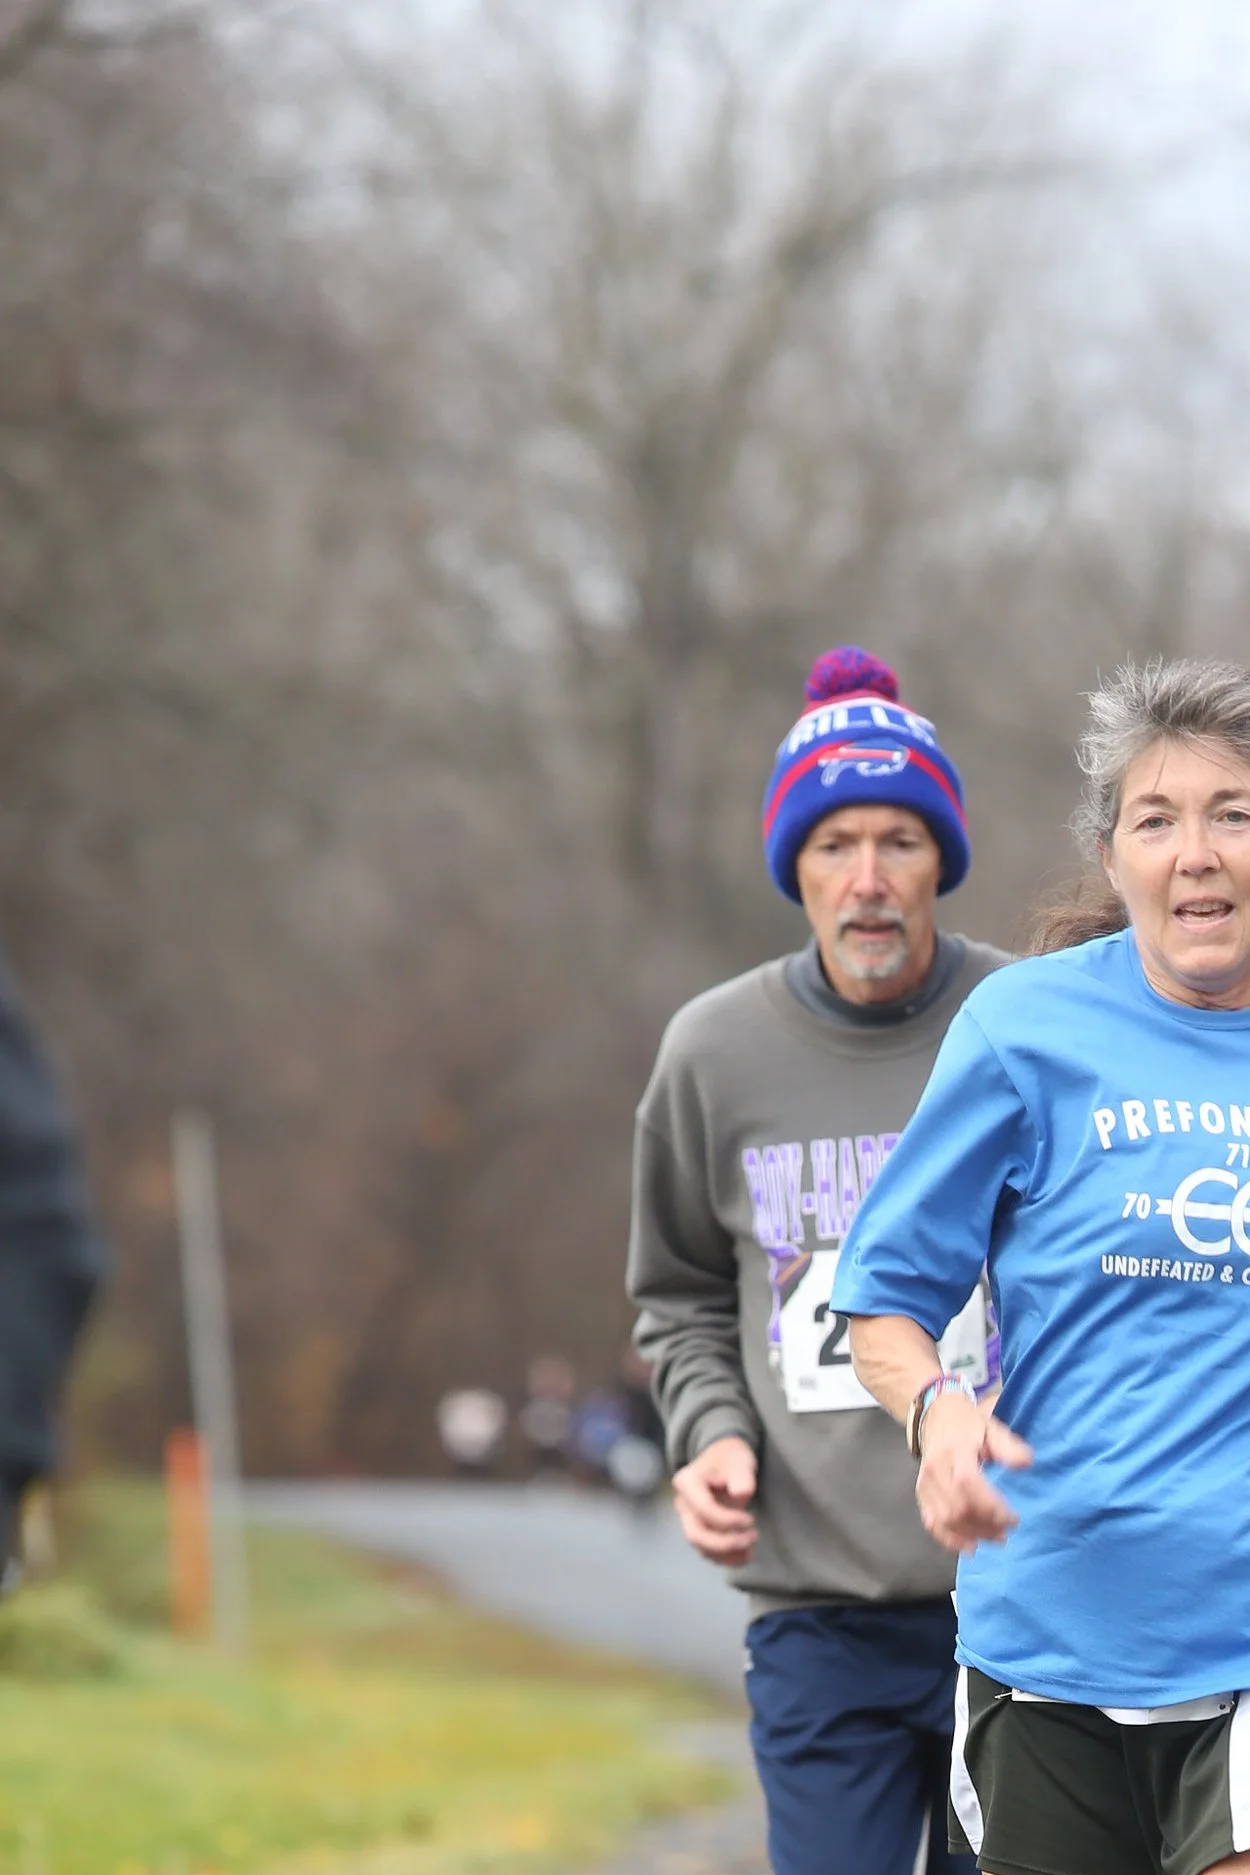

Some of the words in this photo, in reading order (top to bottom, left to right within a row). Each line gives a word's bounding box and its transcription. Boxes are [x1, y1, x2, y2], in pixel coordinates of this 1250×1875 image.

[1224, 1142, 1250, 1169] 71
[1121, 1191, 1151, 1220] 70
[1101, 1254, 1215, 1282] UNDEFEATED
[1220, 1265, 1233, 1283] &
